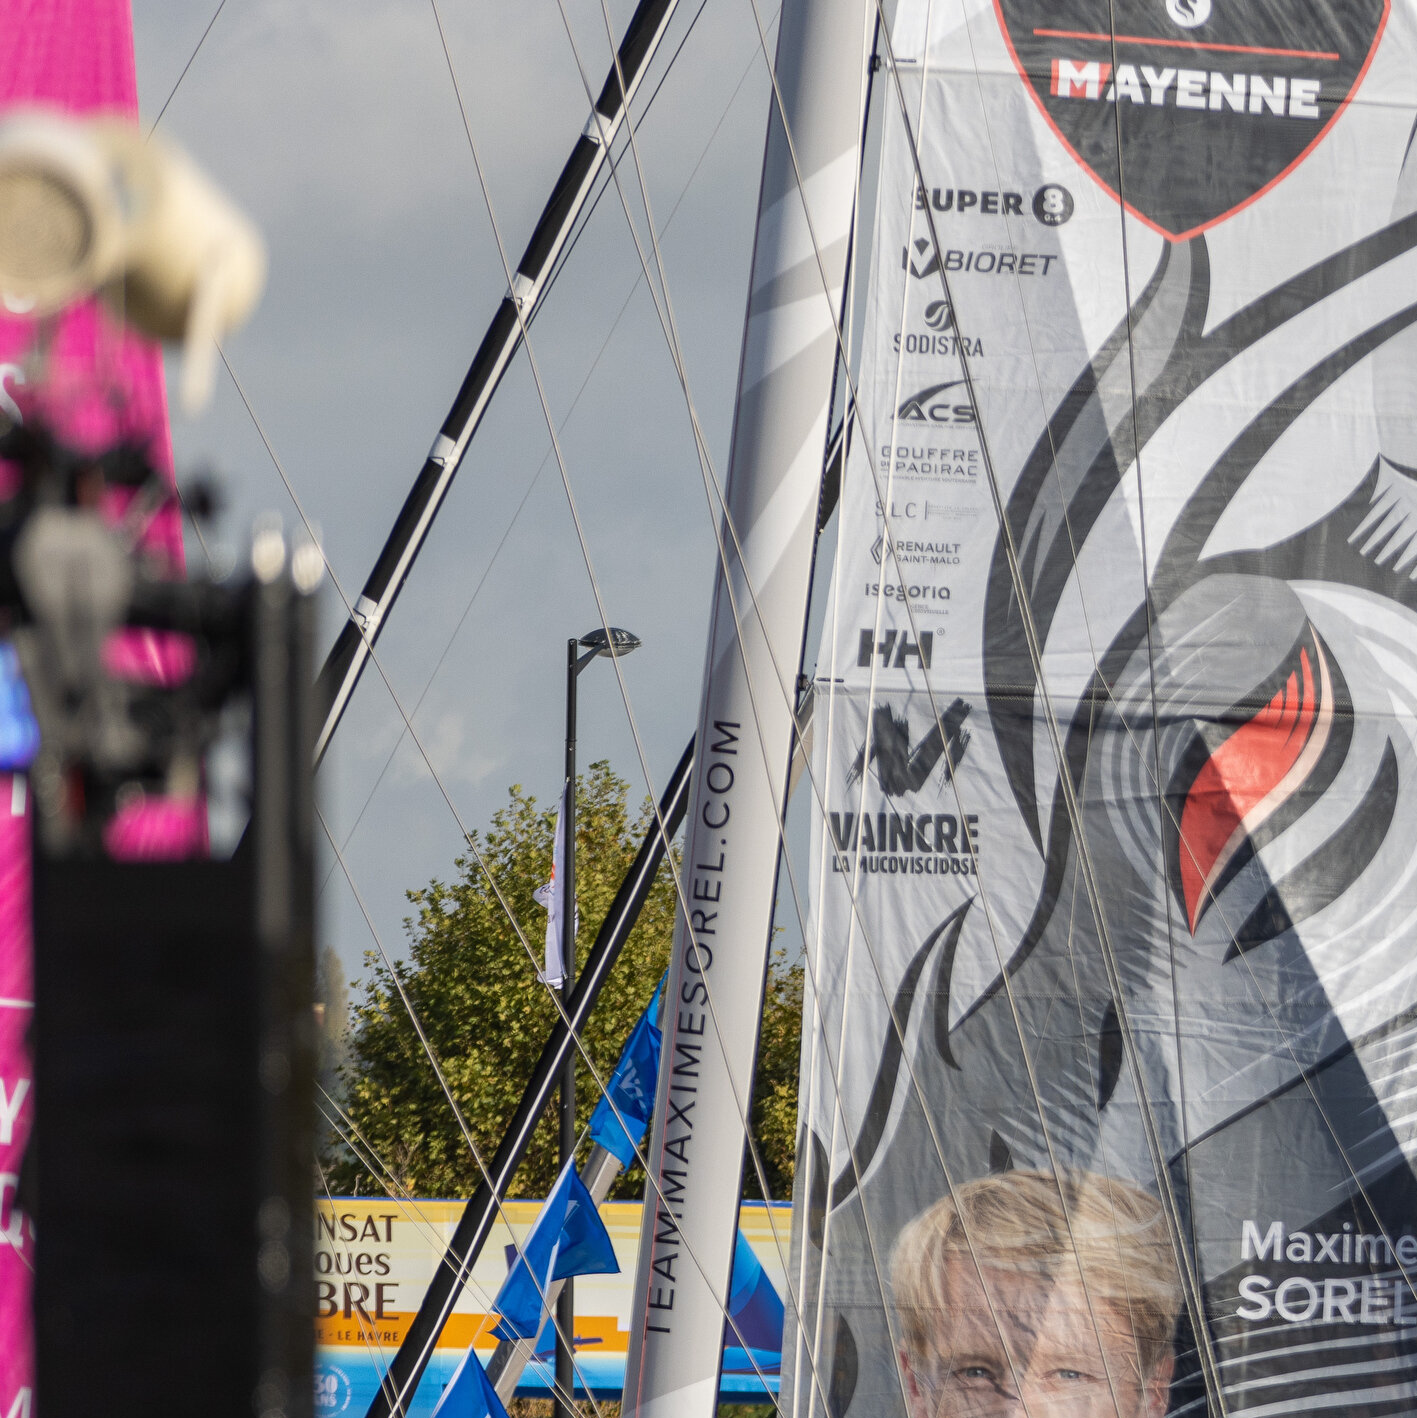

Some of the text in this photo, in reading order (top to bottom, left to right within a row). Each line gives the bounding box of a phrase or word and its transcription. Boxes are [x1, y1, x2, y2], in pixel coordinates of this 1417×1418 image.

[1056, 59, 1320, 118] MAYENNE
[911, 187, 1065, 215] SUPER 8
[944, 250, 1057, 275] BIORET
[893, 333, 984, 357] SODISTRA
[893, 400, 977, 423] ACS
[881, 445, 978, 461] GOUFFRE
[895, 461, 977, 476] PADIRAC
[875, 500, 917, 518] SLC
[896, 540, 961, 554] RENAULT
[896, 554, 961, 565] SAINT-MALO
[865, 582, 951, 602] isegoria
[829, 812, 979, 854] VAINCRE
[832, 855, 978, 876] LA MUCOVISCIDOSE
[644, 718, 743, 1336] TEAMMAXIMESOREL.COM
